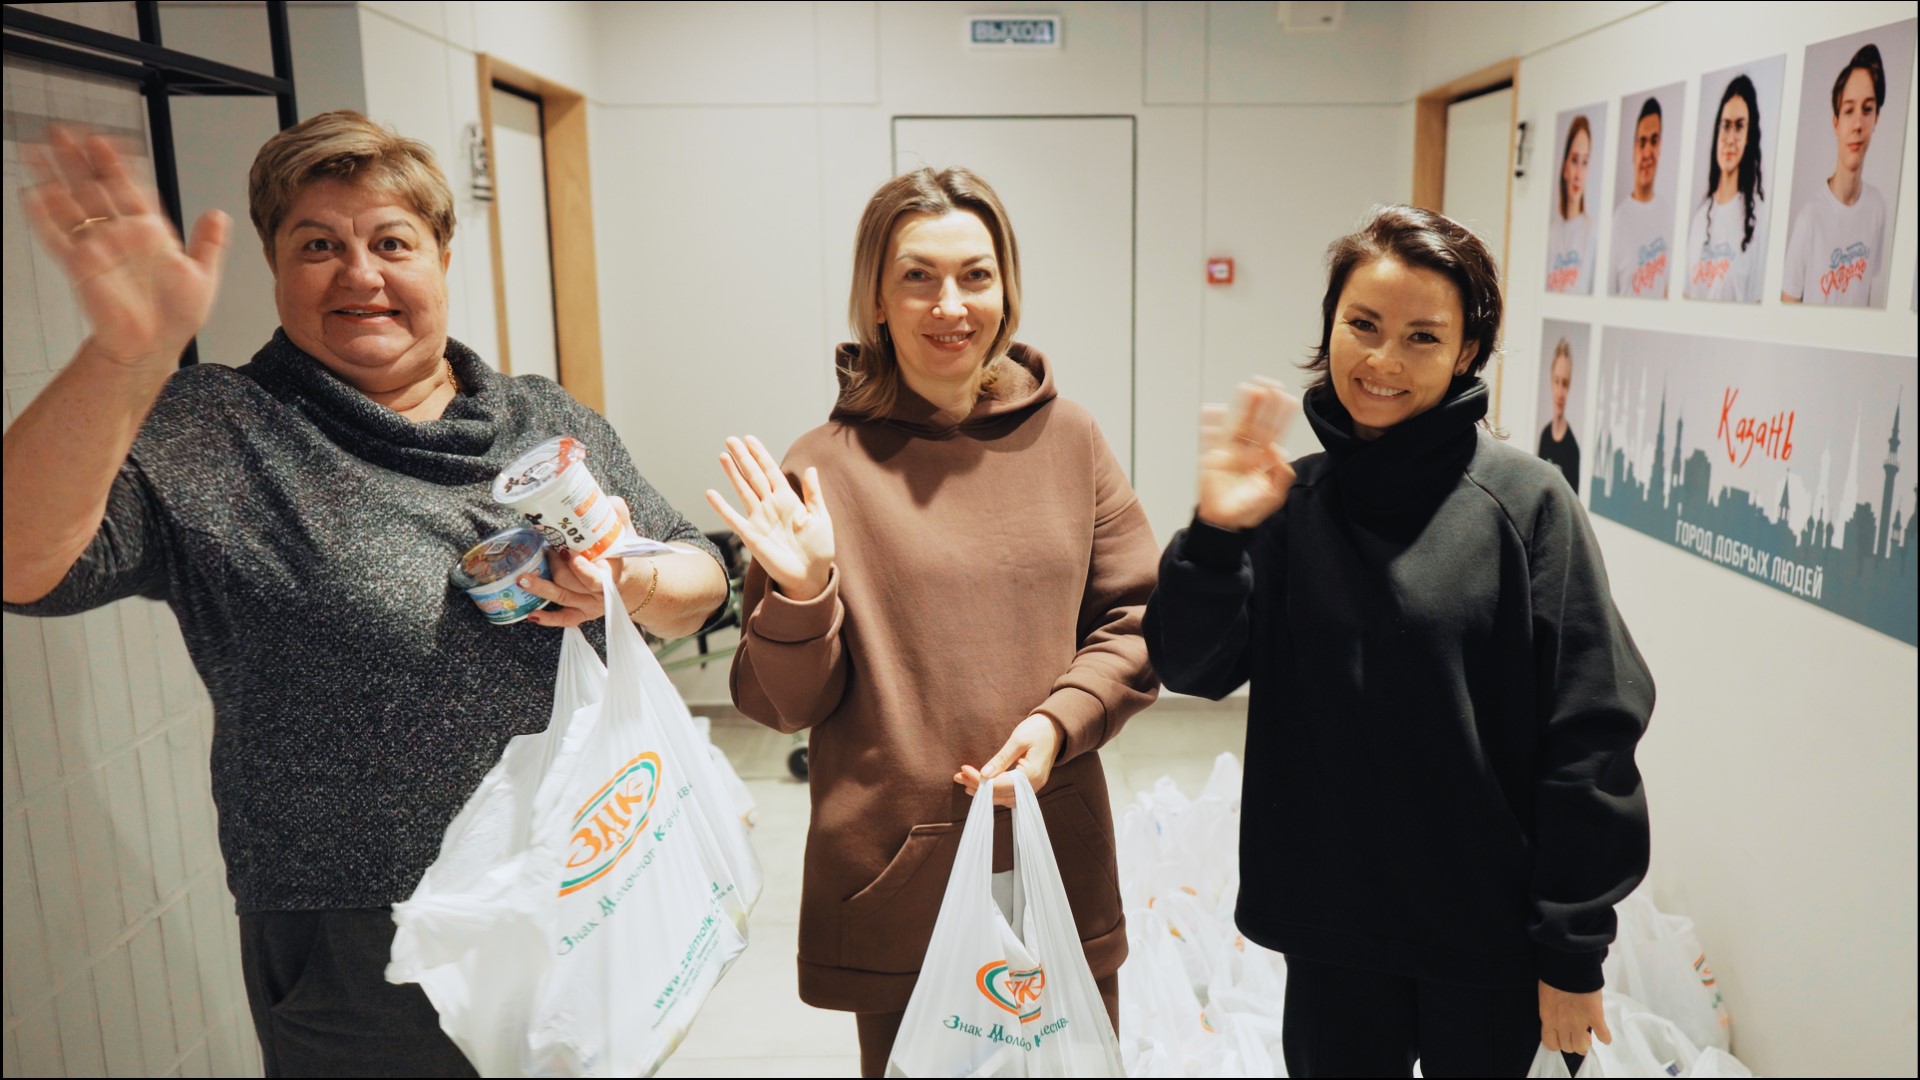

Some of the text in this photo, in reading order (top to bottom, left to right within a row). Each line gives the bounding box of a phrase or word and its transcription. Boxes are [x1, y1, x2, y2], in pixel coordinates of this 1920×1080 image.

[975, 22, 1051, 41] ВЫХОД
[1717, 386, 1795, 468] Казань
[558, 517, 586, 544] 20%
[1675, 519, 1824, 600] ГОРОД ДОБРЫХ ЛЮДЕЙ
[943, 1014, 982, 1037] Знак
